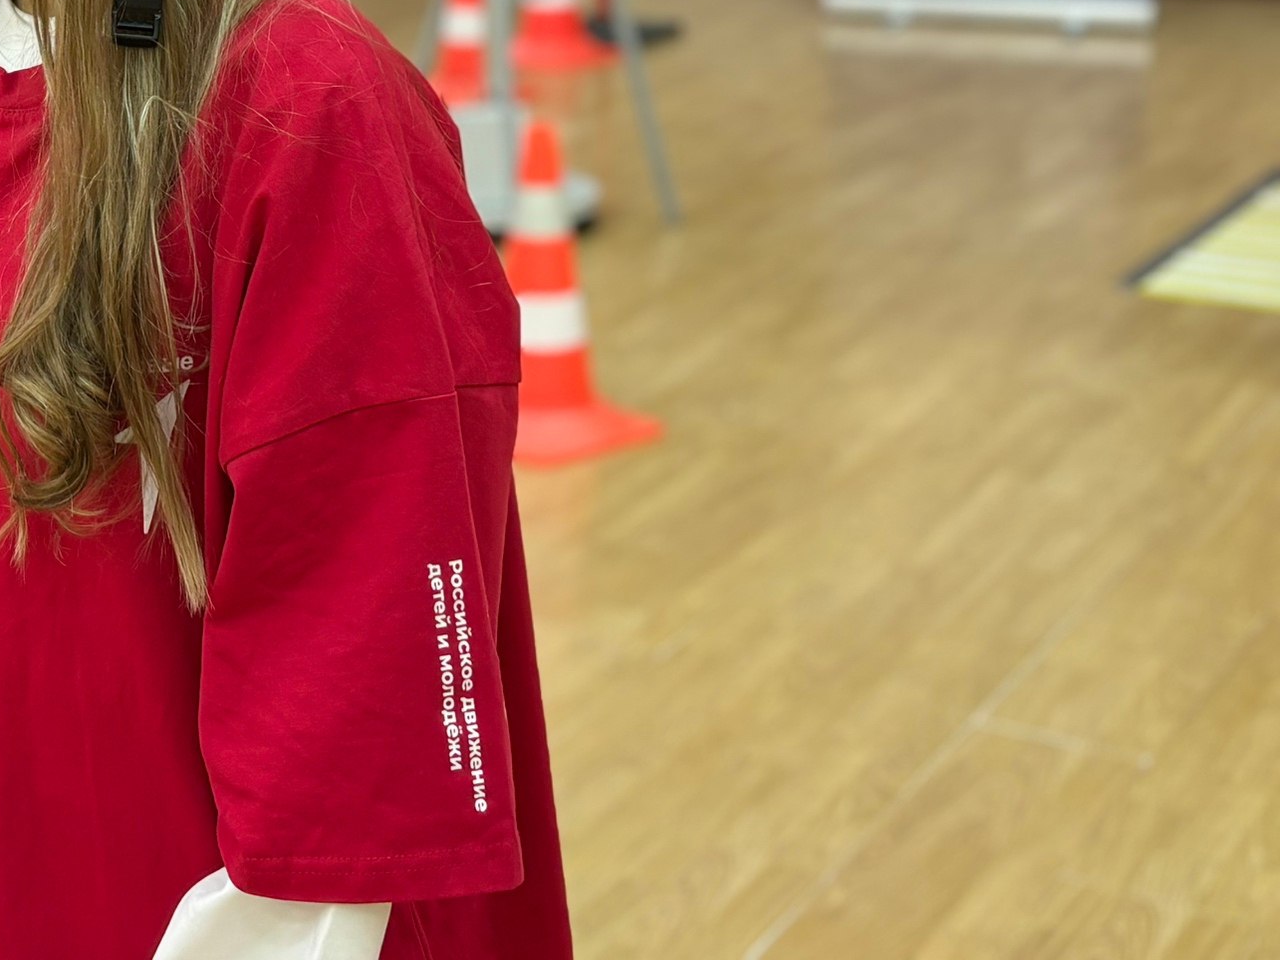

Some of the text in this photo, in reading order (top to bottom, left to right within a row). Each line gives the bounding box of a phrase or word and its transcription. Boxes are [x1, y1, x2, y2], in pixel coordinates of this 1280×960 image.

[427, 563, 463, 772] детей и молодёжи
[448, 559, 488, 813] Российское движение
